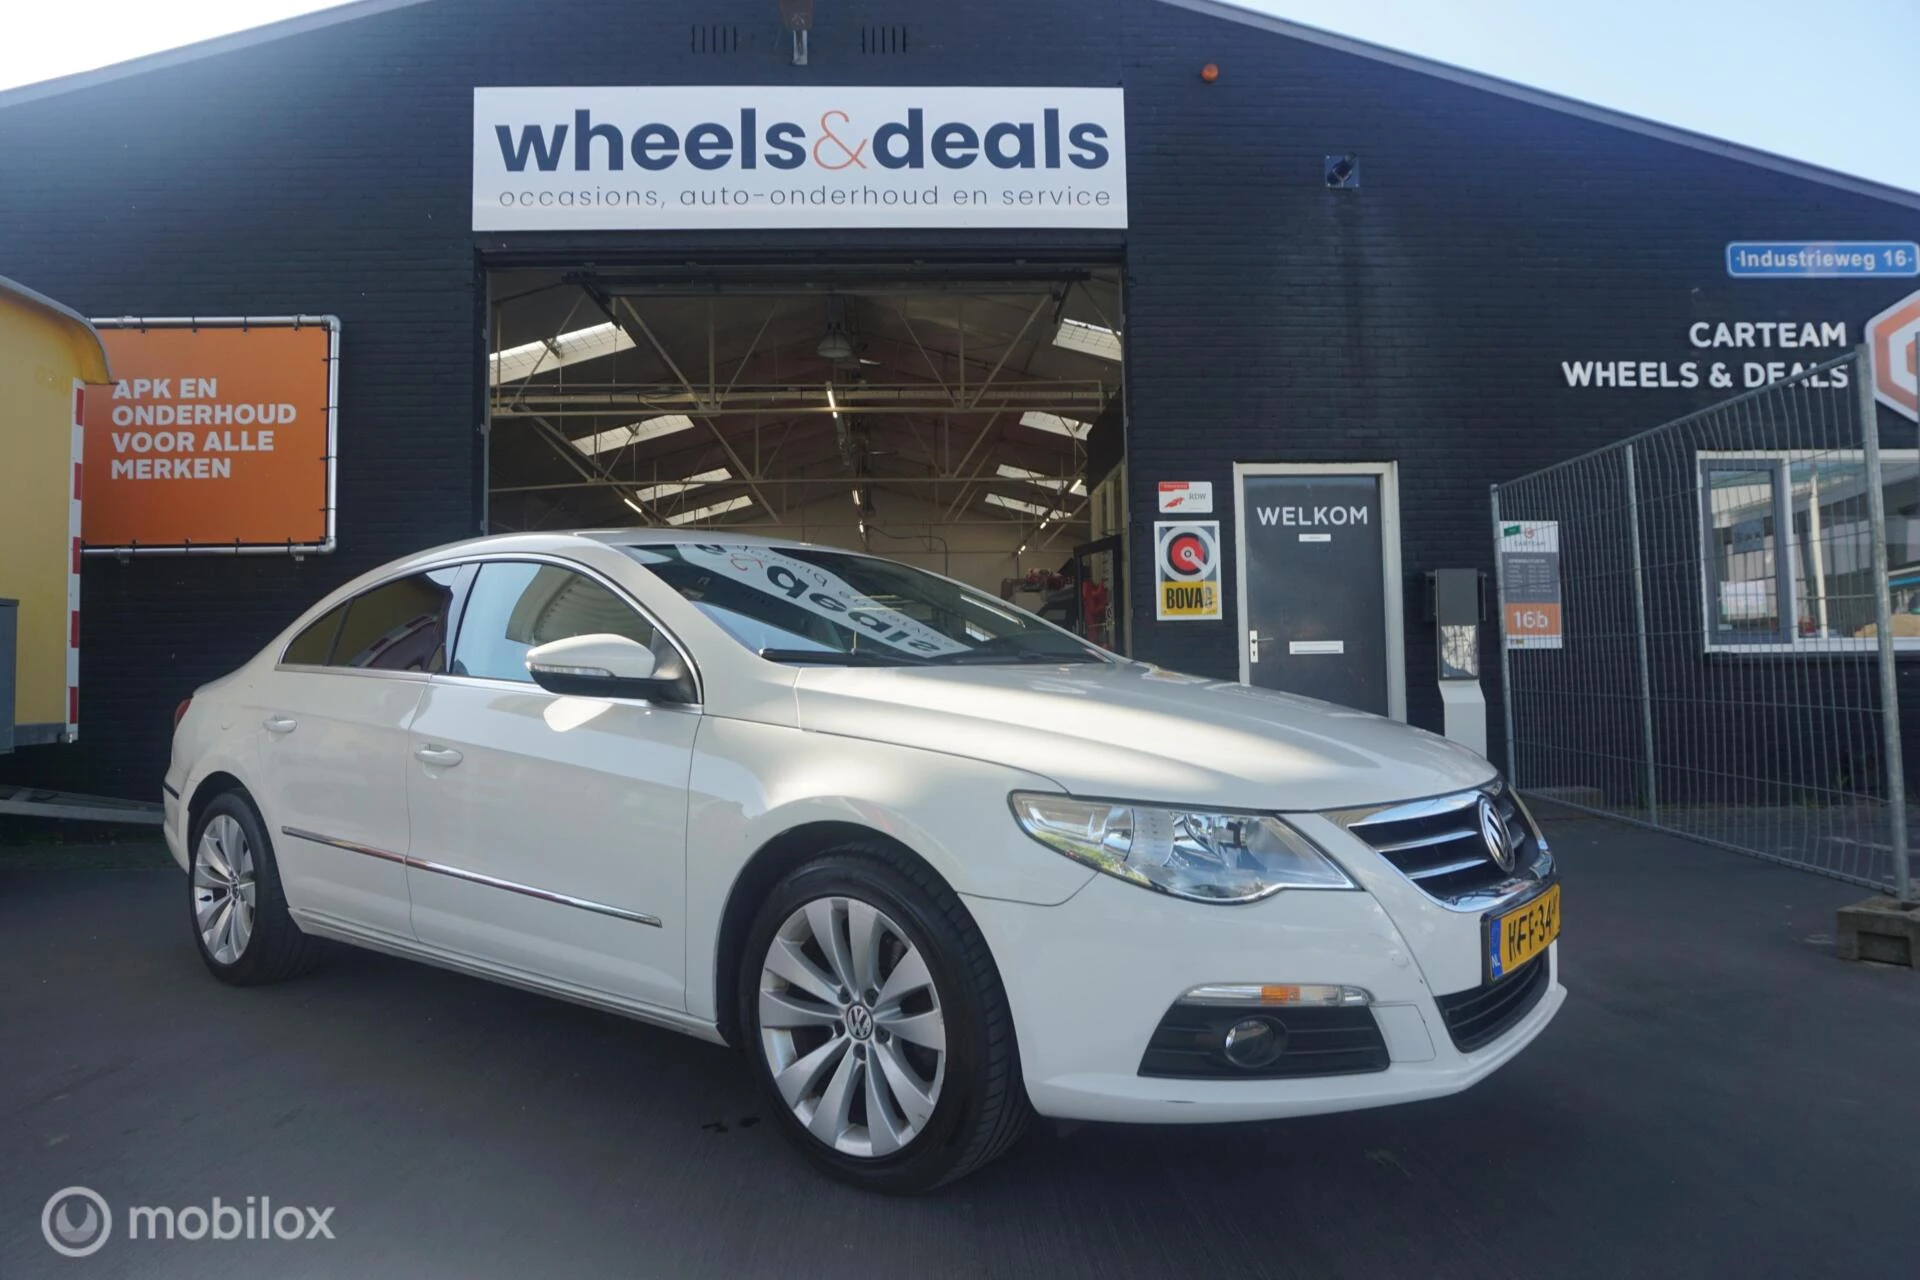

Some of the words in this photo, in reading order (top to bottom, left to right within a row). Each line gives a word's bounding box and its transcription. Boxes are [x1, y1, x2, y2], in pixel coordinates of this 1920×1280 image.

[499, 186, 667, 209] occasions,
[680, 185, 939, 206] auto-onderhoud
[953, 188, 988, 205] en
[1002, 186, 1111, 206] service
[1740, 249, 1876, 271] Industrieweg
[1883, 249, 1907, 267] 16
[1689, 322, 1847, 348] CARTEAM
[1562, 361, 1700, 388] WHEELS
[1709, 362, 1733, 388] &
[1744, 362, 1849, 388] DEALS
[112, 378, 171, 399] APK
[180, 378, 217, 398] EN
[111, 403, 297, 426] ONDERHOUD
[111, 431, 194, 453] VOOR
[202, 431, 274, 451] ALLE
[111, 458, 231, 480] MERKEN
[1256, 505, 1368, 526] WELKOM
